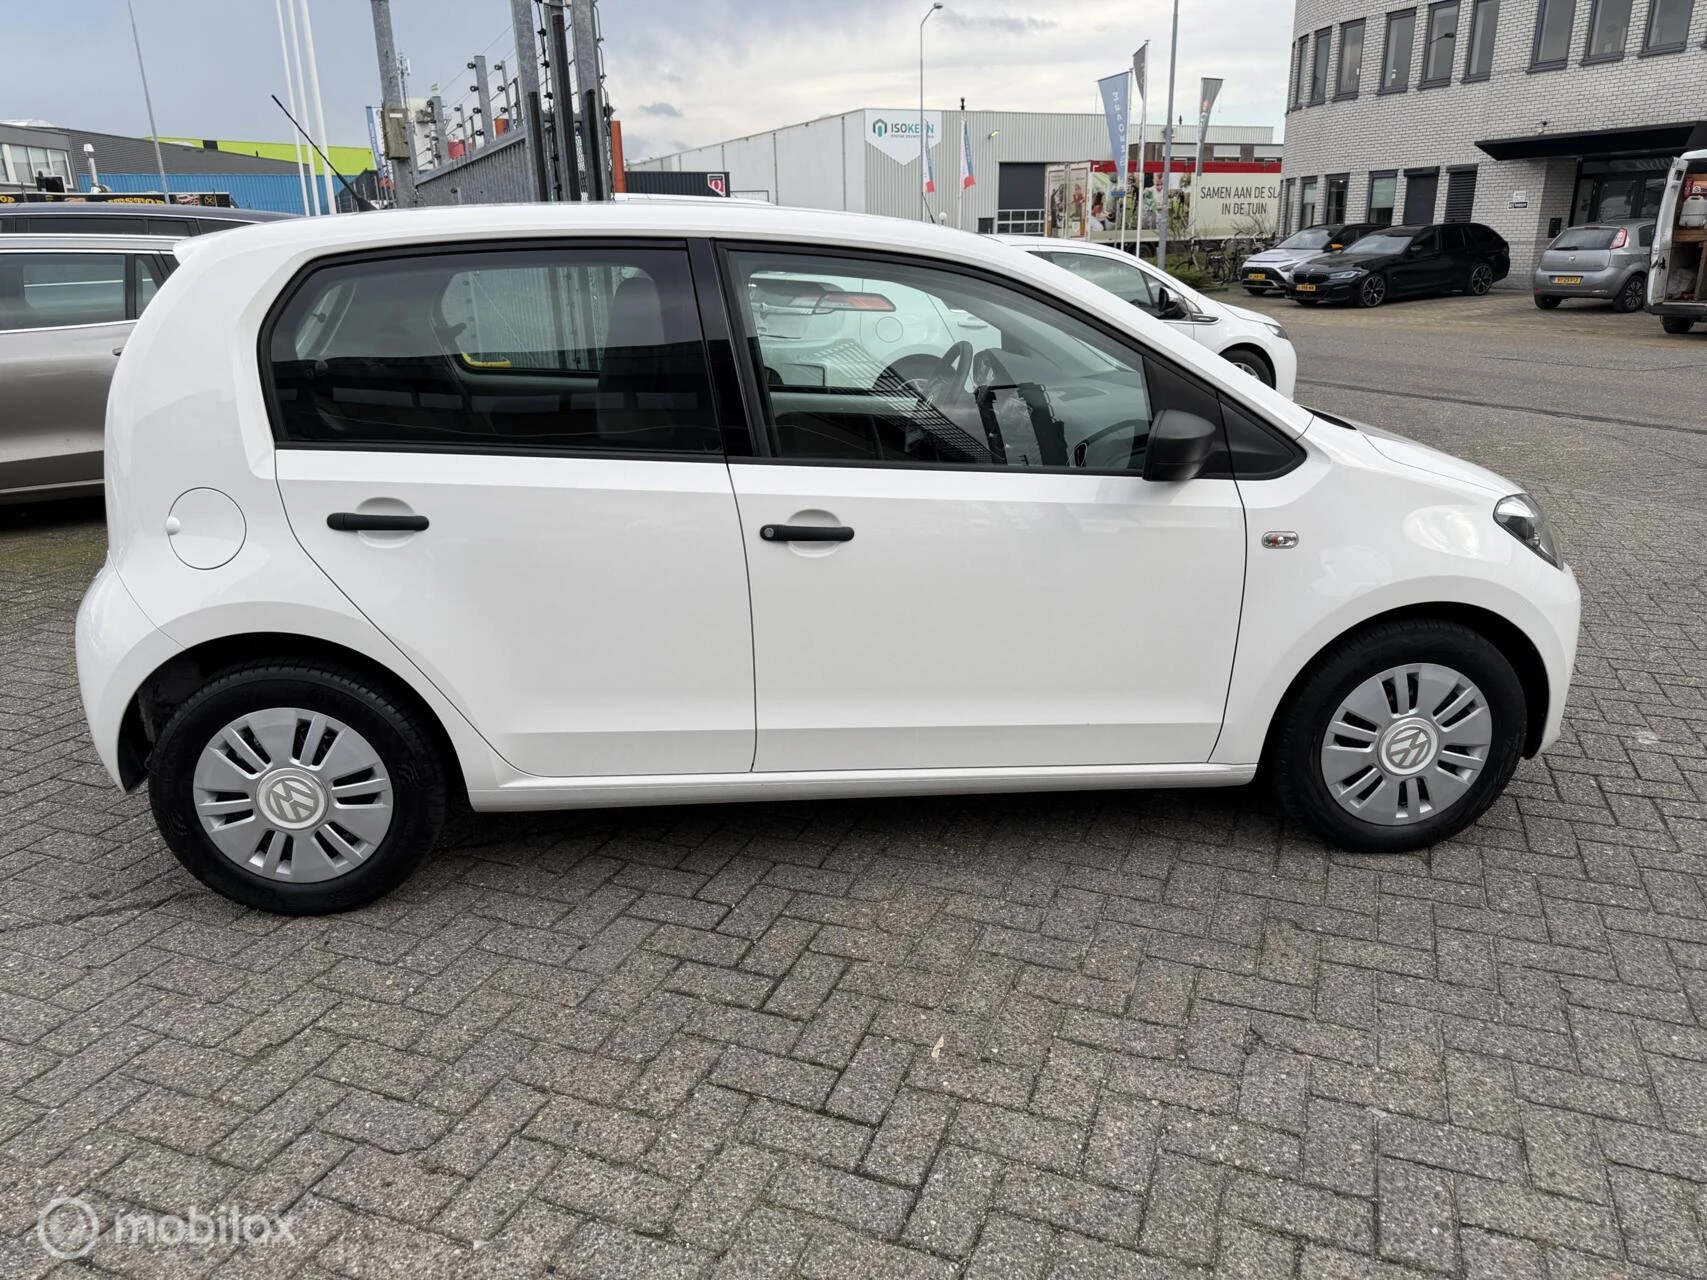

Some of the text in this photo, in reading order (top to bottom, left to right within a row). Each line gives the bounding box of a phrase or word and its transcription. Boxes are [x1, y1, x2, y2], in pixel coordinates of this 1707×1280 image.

[891, 123, 934, 133] ISOKEN
[1200, 186, 1232, 199] SAMEN
[1233, 186, 1252, 198] AAN
[1254, 186, 1266, 199] DE
[1221, 202, 1267, 215] IN DE TUIN
